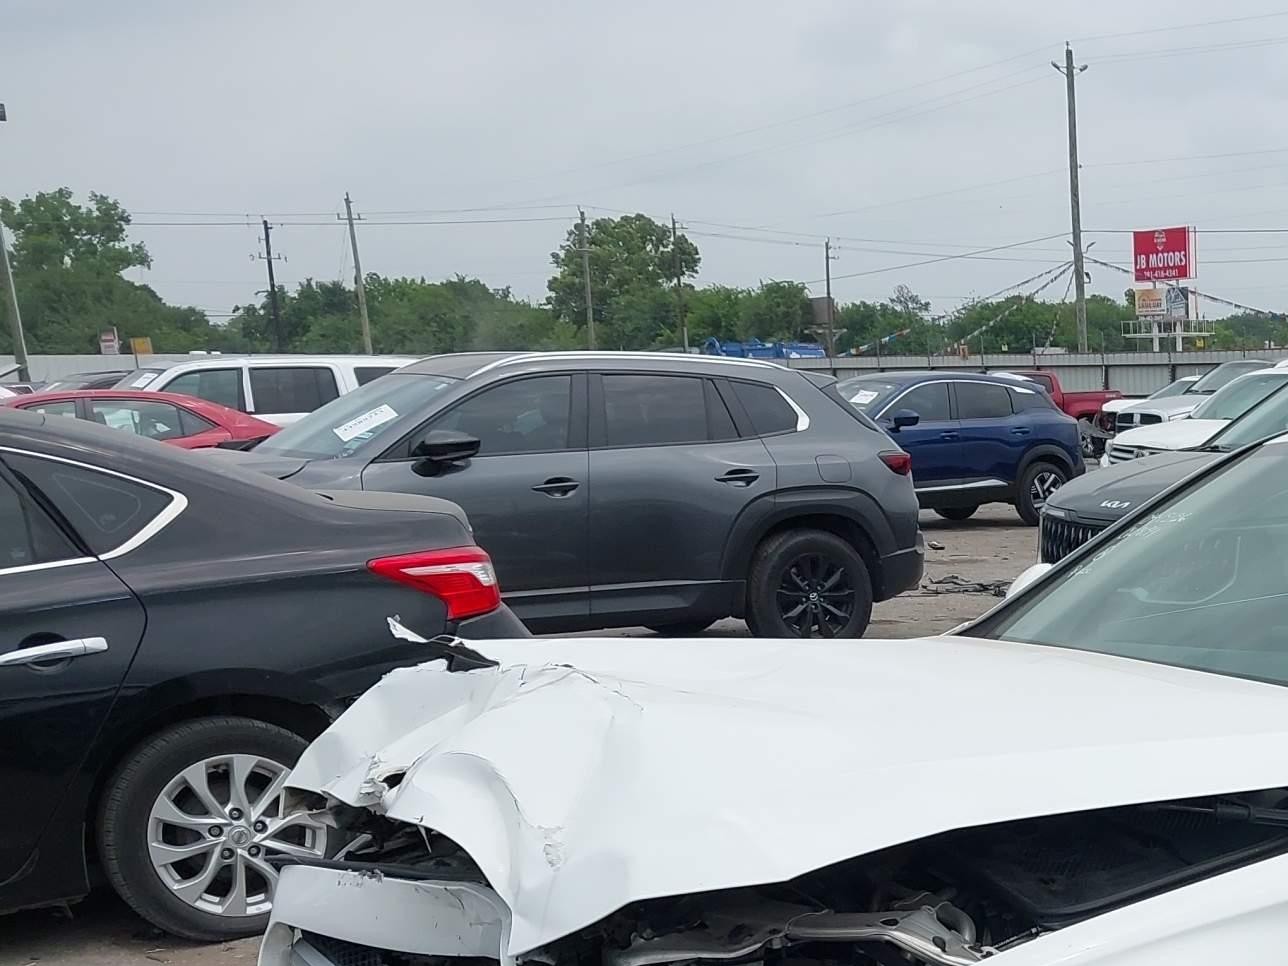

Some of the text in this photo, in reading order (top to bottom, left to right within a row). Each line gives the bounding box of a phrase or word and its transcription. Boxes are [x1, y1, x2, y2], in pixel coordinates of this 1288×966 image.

[1136, 251, 1186, 269] JB MOTORS
[1100, 501, 1131, 509] KIA
